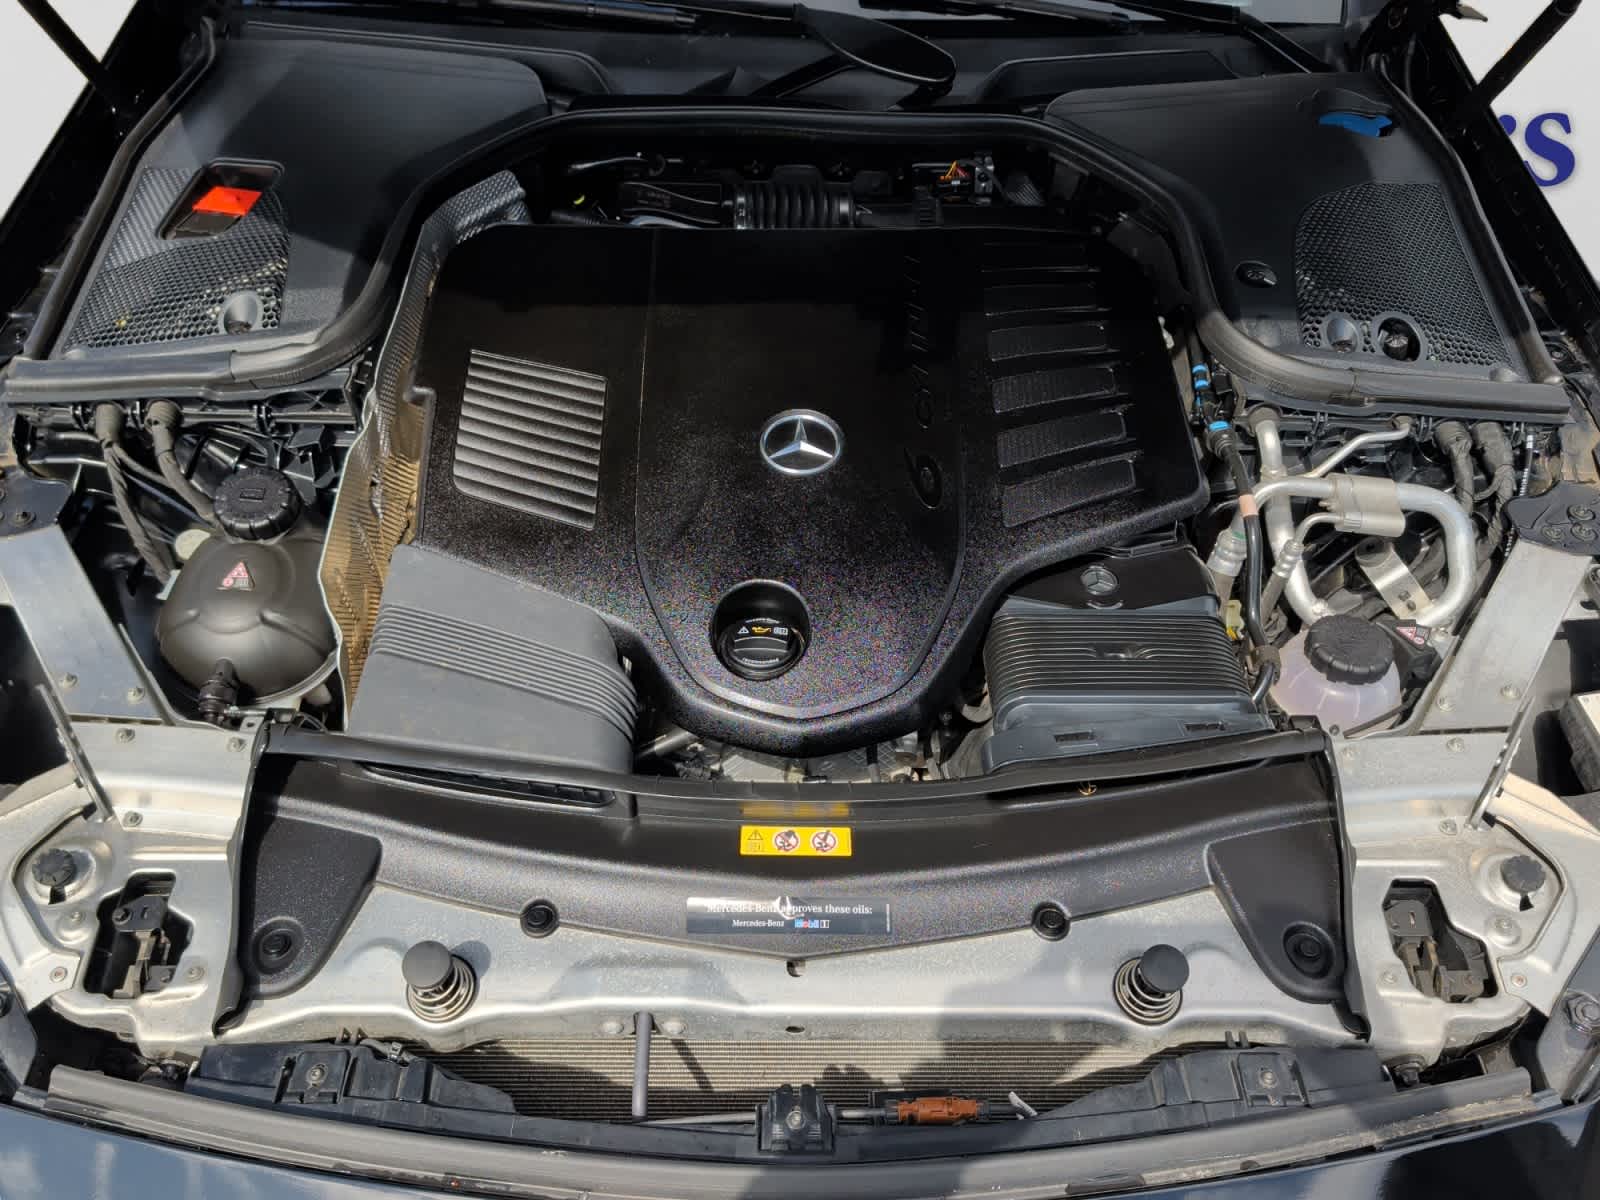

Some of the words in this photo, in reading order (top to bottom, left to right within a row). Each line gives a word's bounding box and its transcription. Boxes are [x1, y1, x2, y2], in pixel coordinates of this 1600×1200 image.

[825, 904, 850, 914] these
[852, 904, 873, 914] oils:
[732, 919, 785, 928] Mercedes-Benz
